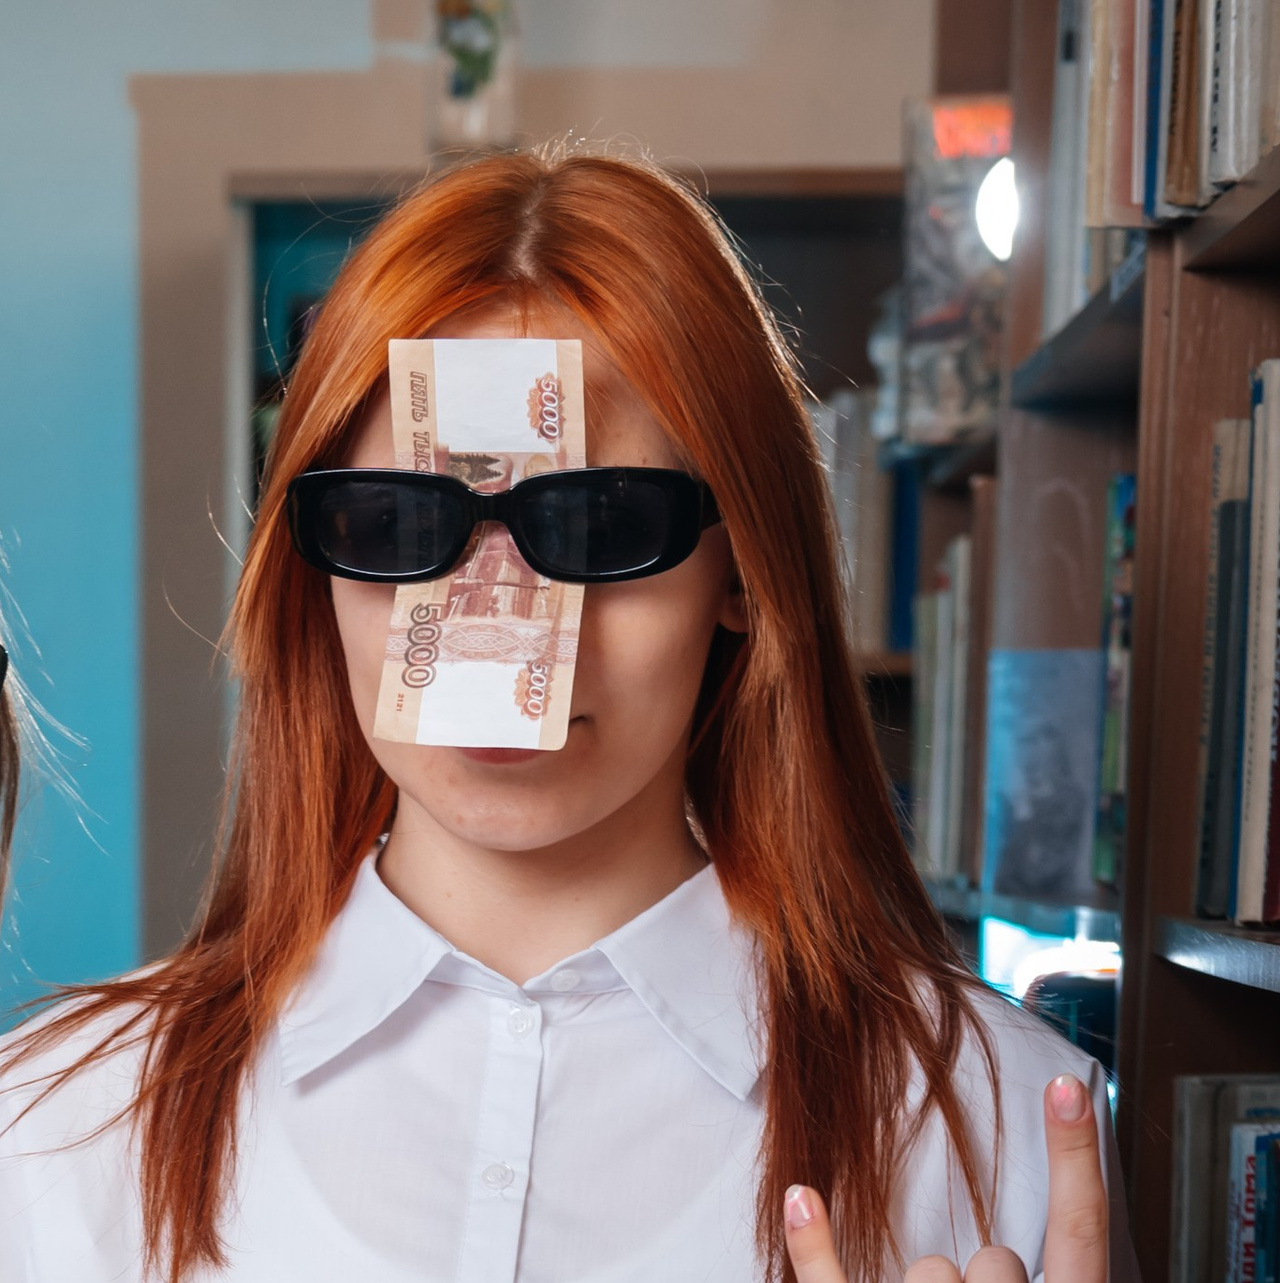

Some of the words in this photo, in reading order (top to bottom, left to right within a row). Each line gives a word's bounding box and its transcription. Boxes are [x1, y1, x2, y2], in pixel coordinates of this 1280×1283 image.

[409, 370, 429, 423] ПЯТЬ
[540, 376, 562, 440] 5000
[413, 431, 432, 473] ТЫС
[401, 602, 444, 689] 5000
[526, 660, 551, 717] 5000
